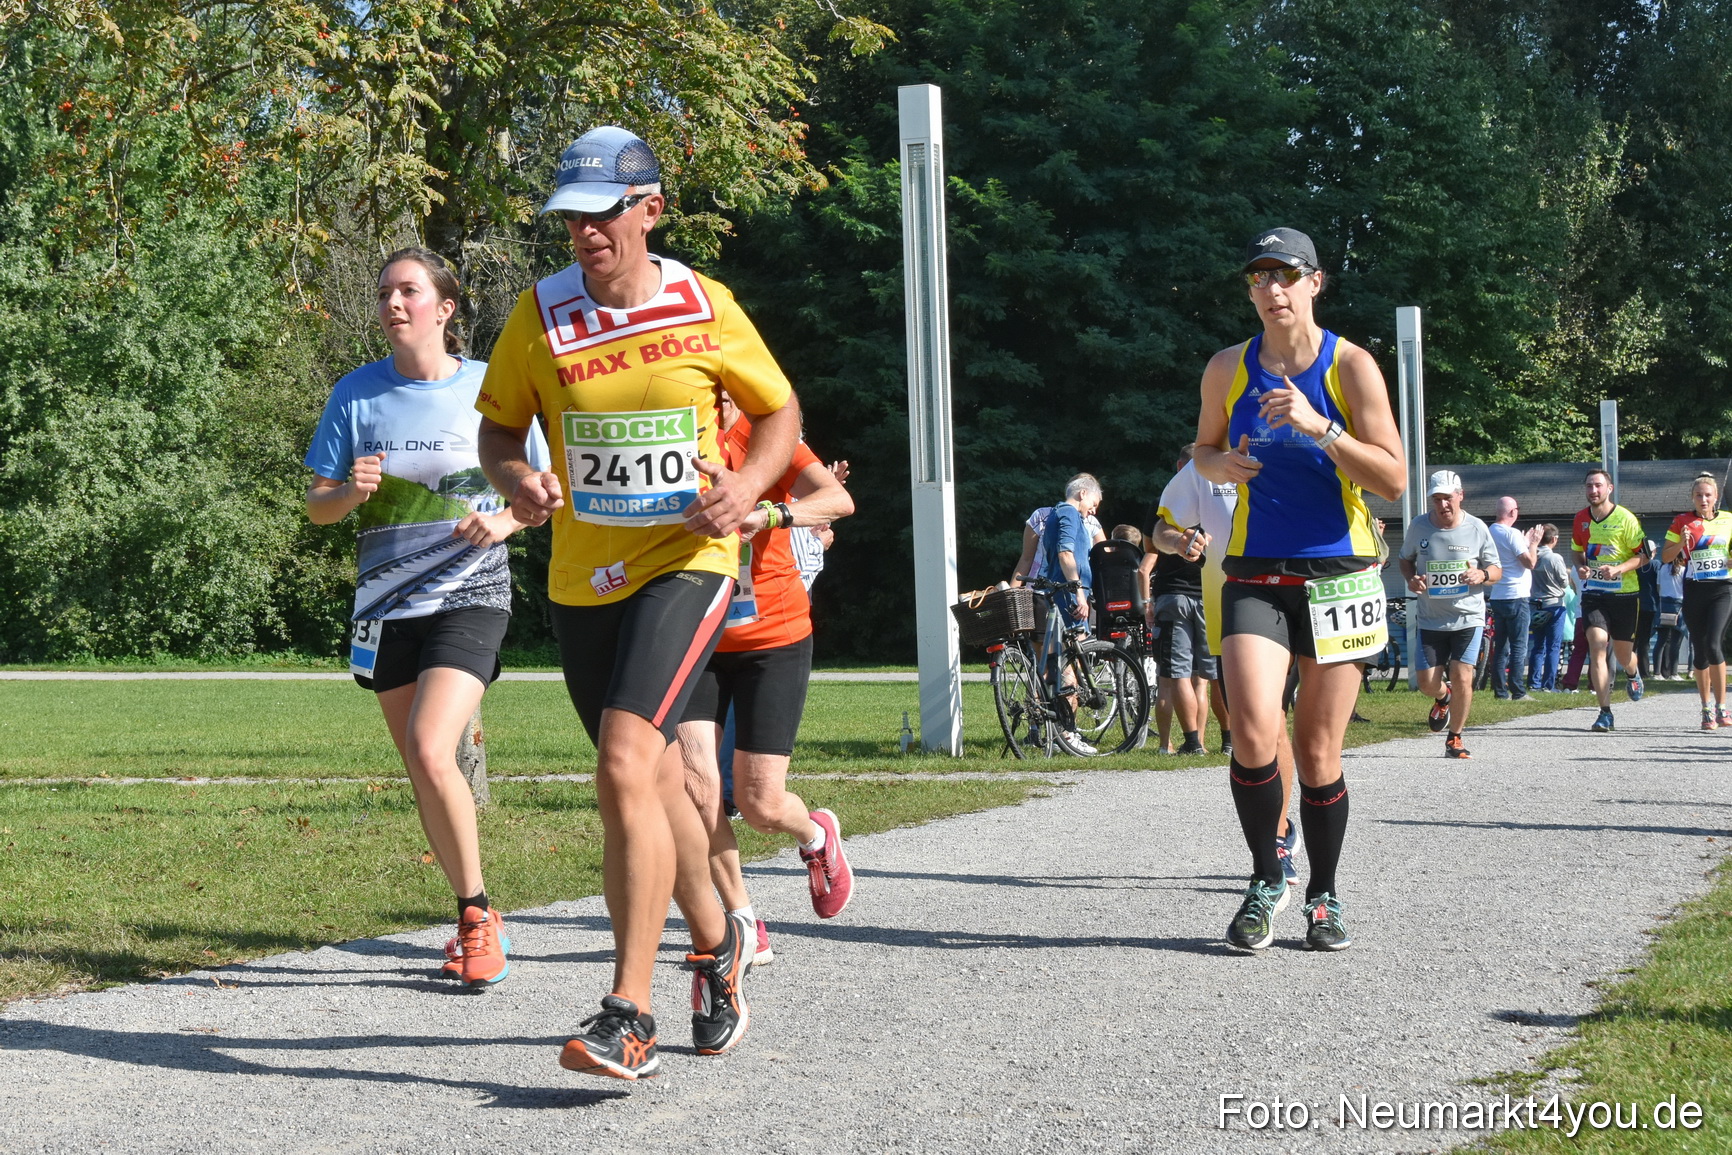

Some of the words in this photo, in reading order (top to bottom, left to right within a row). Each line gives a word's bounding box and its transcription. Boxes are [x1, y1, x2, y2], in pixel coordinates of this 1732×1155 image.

[560, 157, 603, 171] QUELLE.
[556, 350, 632, 388] MAX
[639, 333, 720, 365] BÖGL
[480, 390, 501, 411] gl.de
[573, 414, 686, 443] BOCK
[581, 450, 684, 487] 2410
[588, 496, 680, 513] ANDREAS
[1696, 559, 1724, 571] 2689
[676, 572, 704, 586] asics
[1592, 569, 1618, 581] 26
[1324, 598, 1382, 632] 1182
[1342, 634, 1376, 650] CINDY
